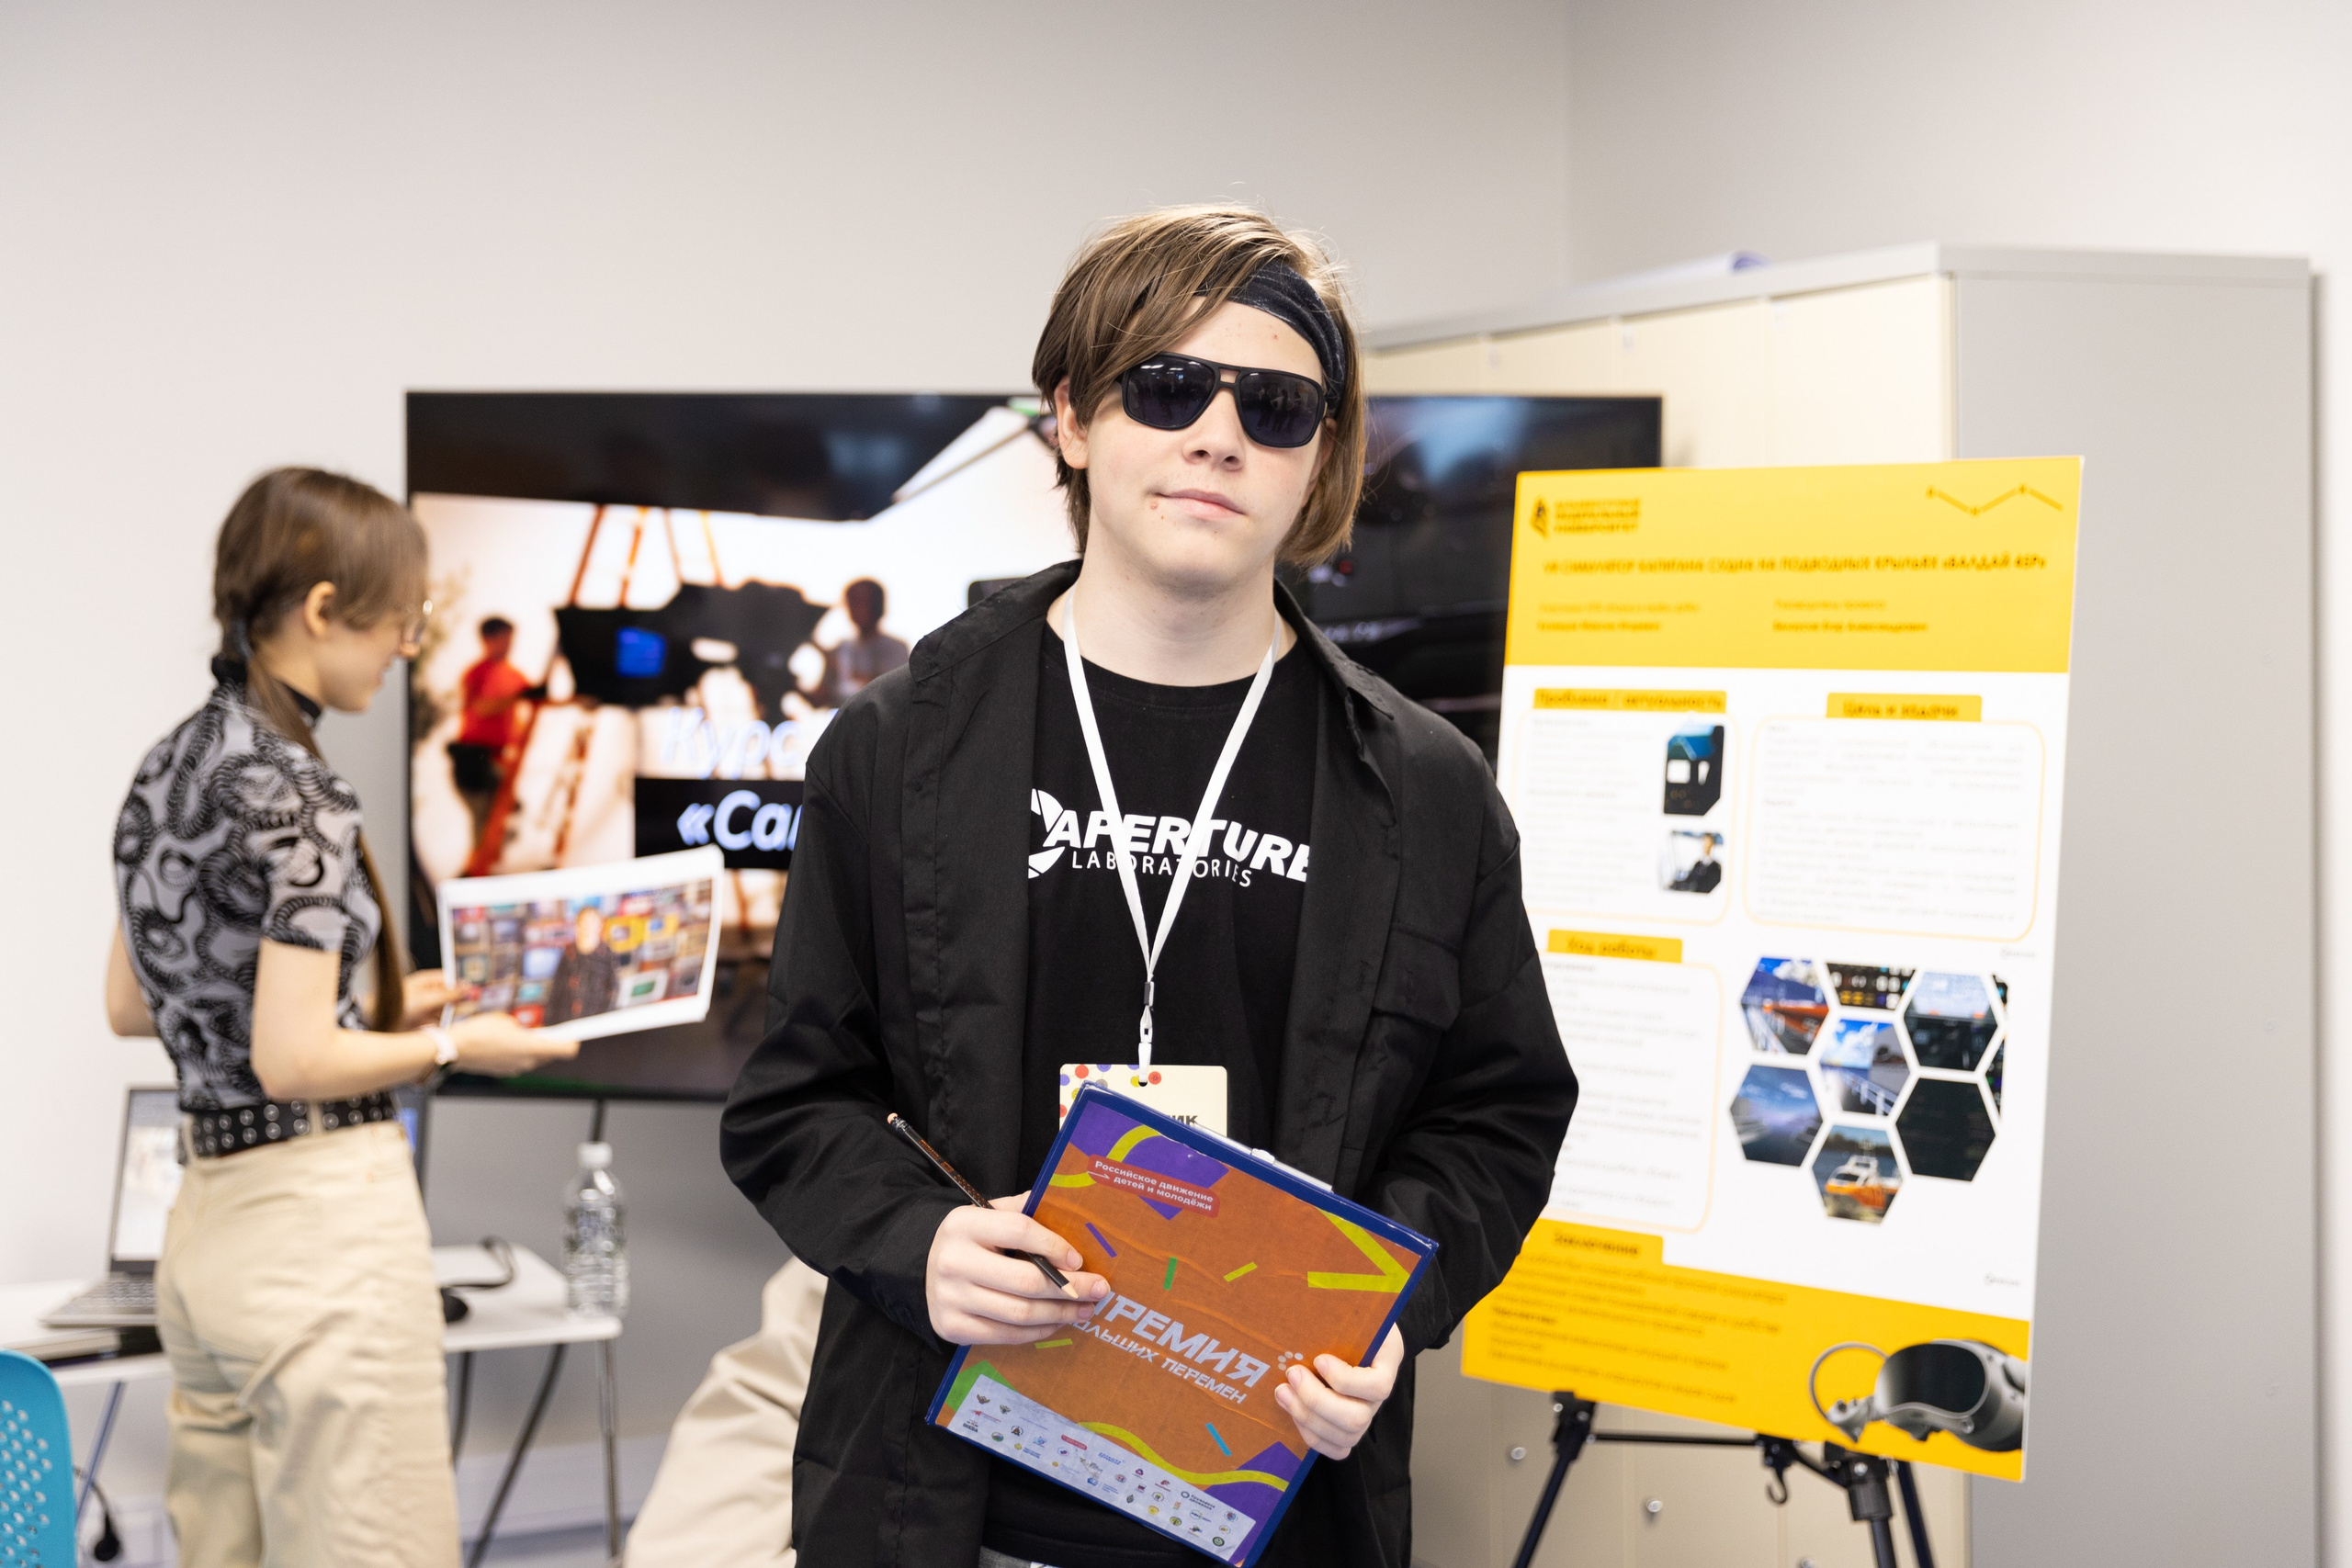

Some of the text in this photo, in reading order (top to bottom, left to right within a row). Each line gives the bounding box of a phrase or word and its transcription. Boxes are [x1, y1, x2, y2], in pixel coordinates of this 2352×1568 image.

[676, 789, 803, 852] «Са
[1094, 1160, 1214, 1203] Российское движение
[1113, 1176, 1213, 1212] детей и молодёжи
[1160, 1357, 1248, 1405] ПЕРЕМЕН
